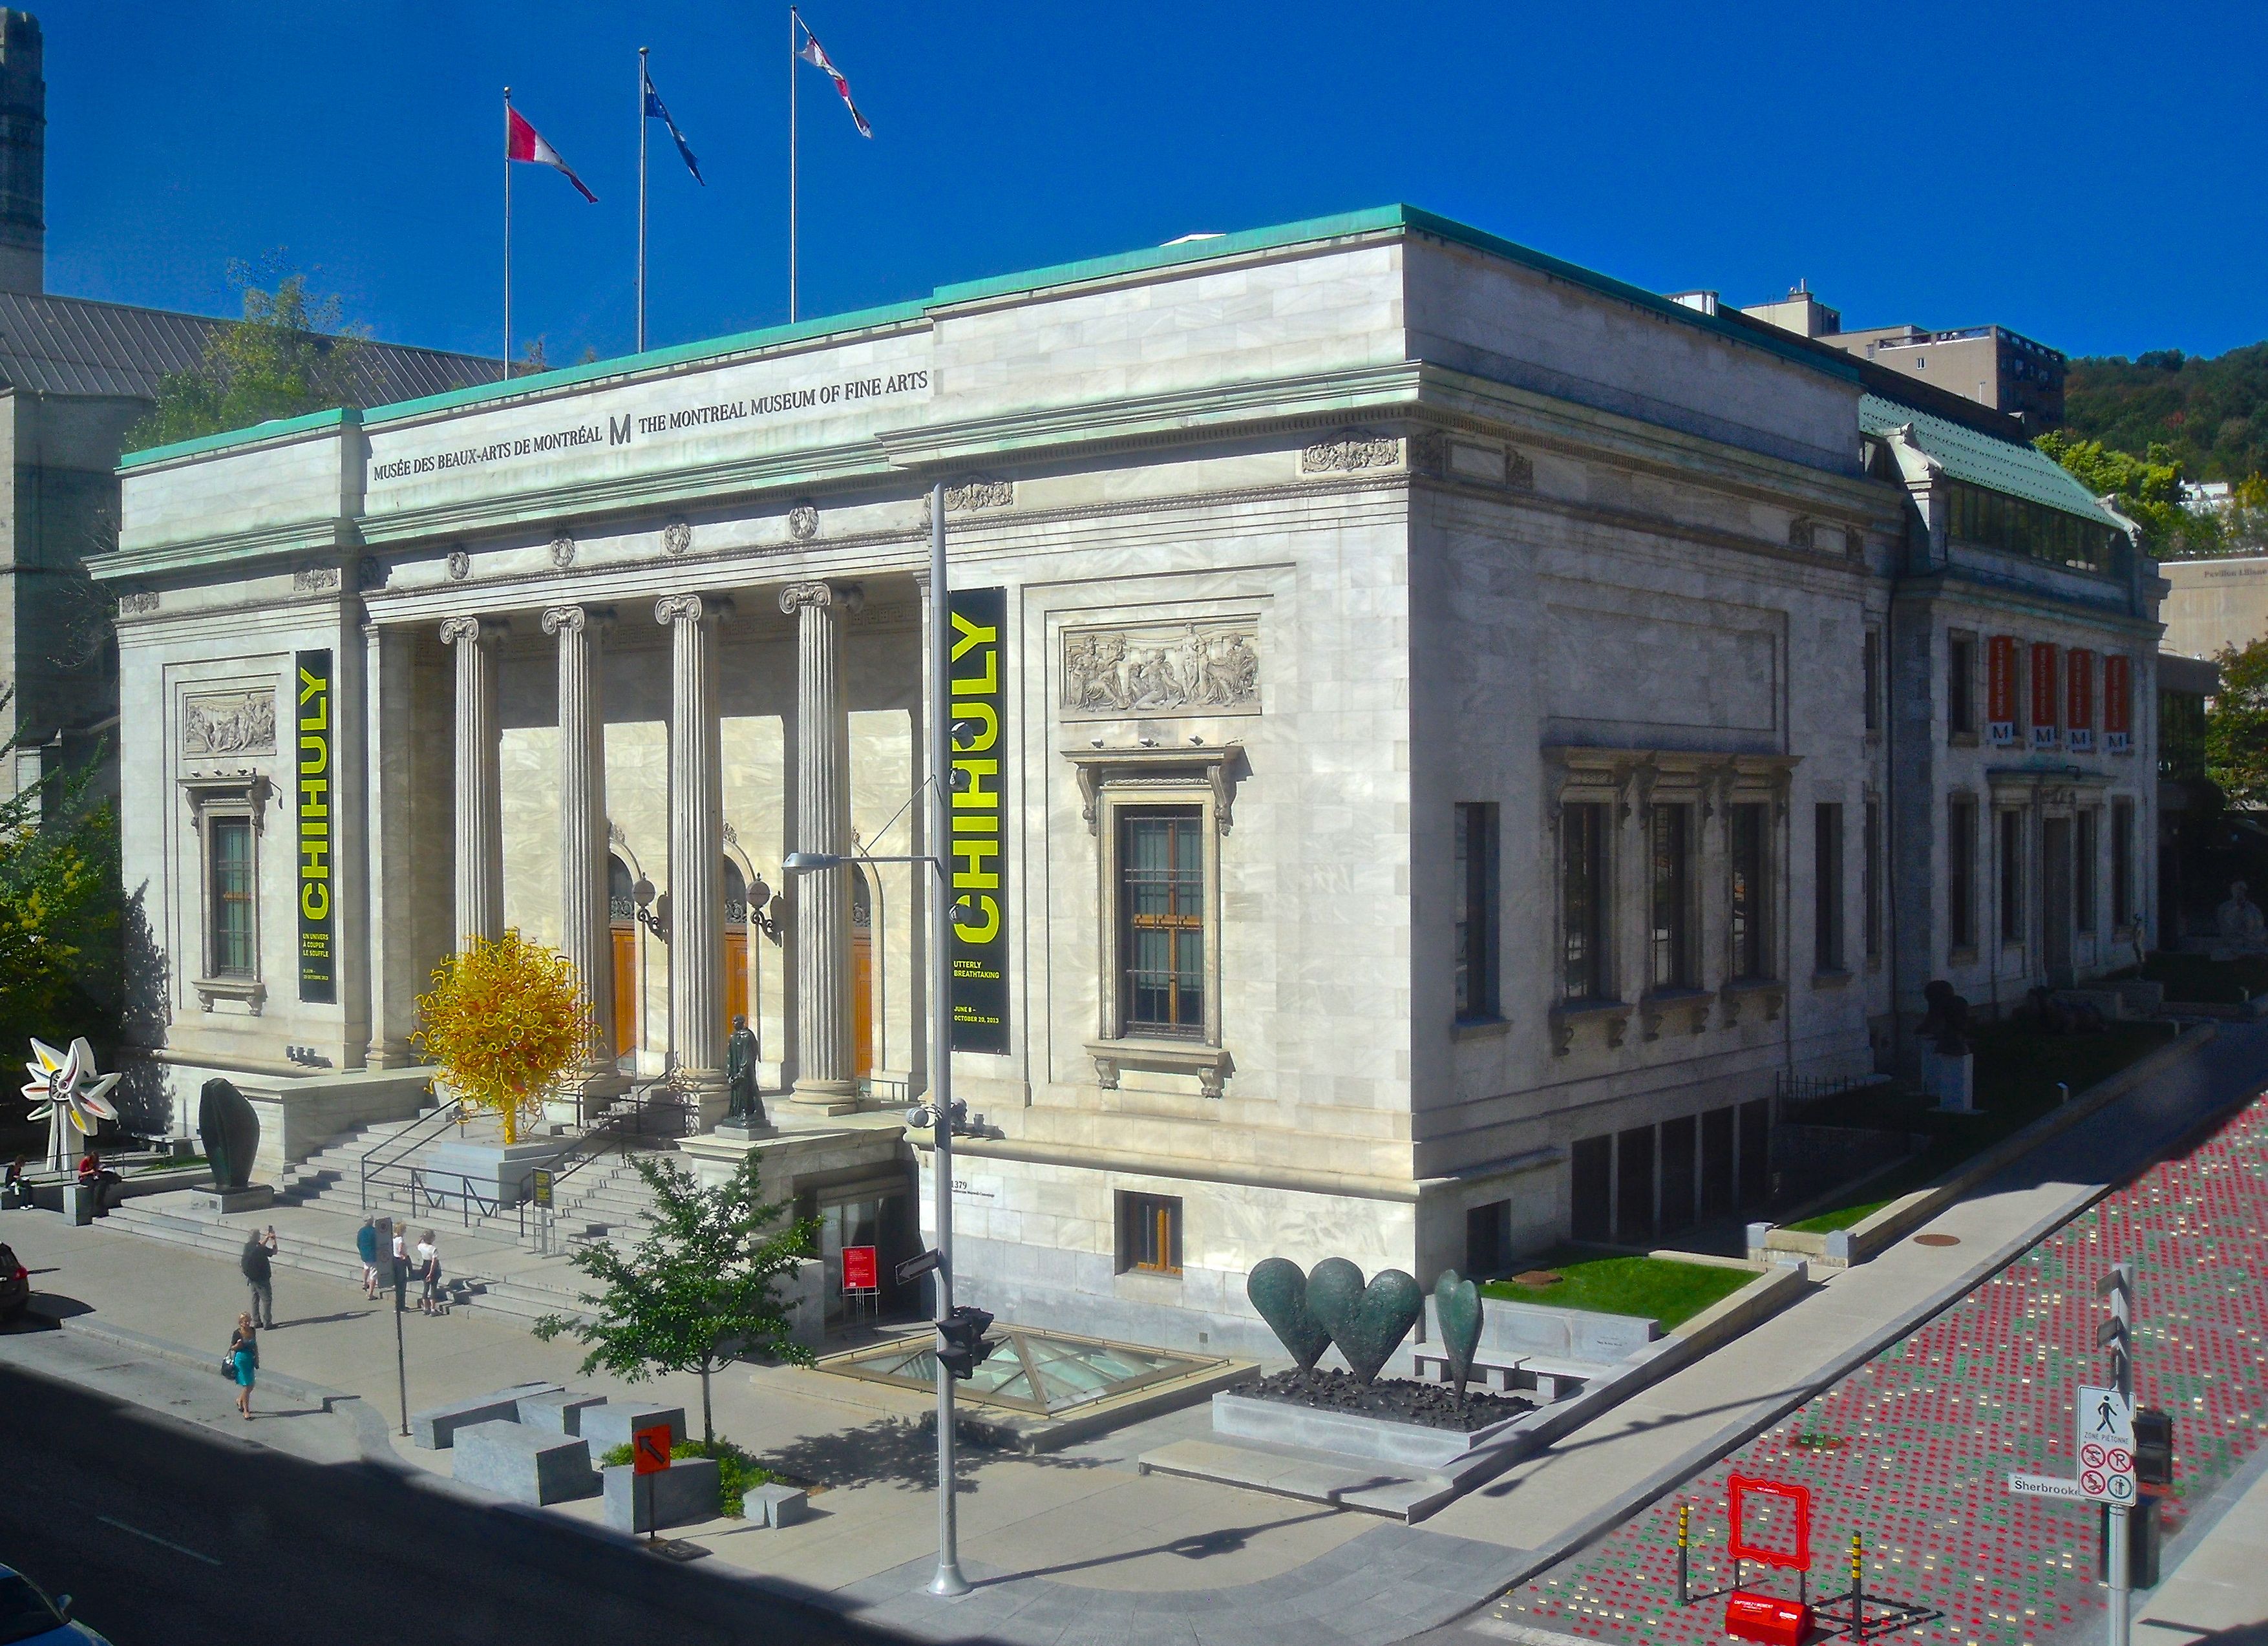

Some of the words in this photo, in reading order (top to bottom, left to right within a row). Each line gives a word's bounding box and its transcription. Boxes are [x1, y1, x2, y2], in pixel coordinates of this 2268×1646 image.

[639, 414, 666, 435] THE
[669, 401, 748, 429] MONTREAL
[751, 388, 816, 416] MUSEUM
[820, 385, 840, 405] OF
[844, 379, 882, 401] FINE
[885, 370, 928, 394] ARTS
[609, 413, 632, 447] M
[374, 458, 411, 481] MUSÉE
[414, 457, 435, 474] DES
[438, 442, 511, 470] BEAUX-ARTS
[514, 439, 531, 456] DE
[533, 425, 603, 453] MONTRÉAL
[300, 667, 328, 920] CHIHULY
[951, 612, 1001, 944] CHIHULY
[953, 960, 982, 969] UTTERLY
[953, 970, 1000, 978] BREATHTAKING
[2084, 1431, 2099, 1440] ZONE
